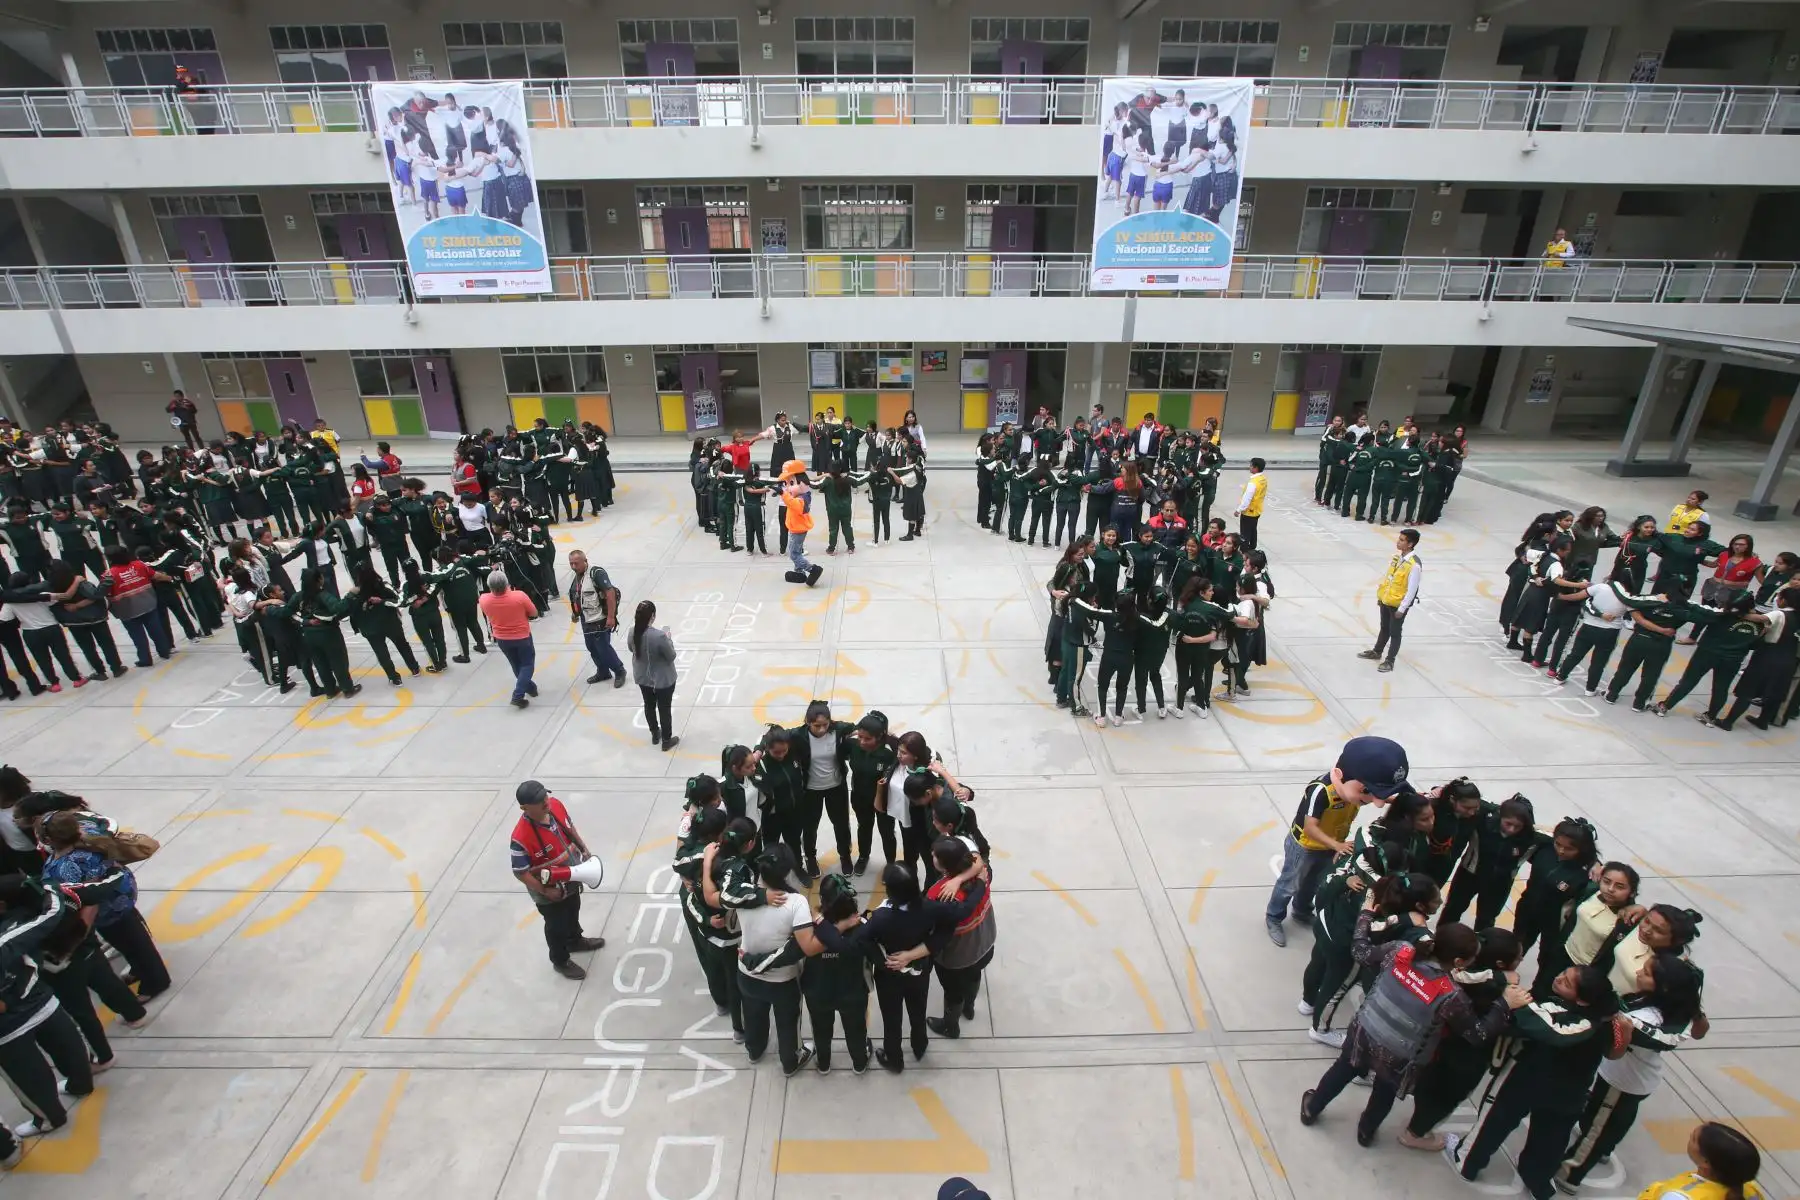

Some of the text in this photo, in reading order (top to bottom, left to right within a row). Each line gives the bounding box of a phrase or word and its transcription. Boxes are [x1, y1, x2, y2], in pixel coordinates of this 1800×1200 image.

[443, 235, 522, 248] SIMULACRO
[1115, 231, 1216, 243] IV SIMULACRO
[425, 248, 522, 259] Nacional Escolar
[1115, 244, 1212, 254] Nacional Escolar
[696, 601, 762, 705] ZONA DE
